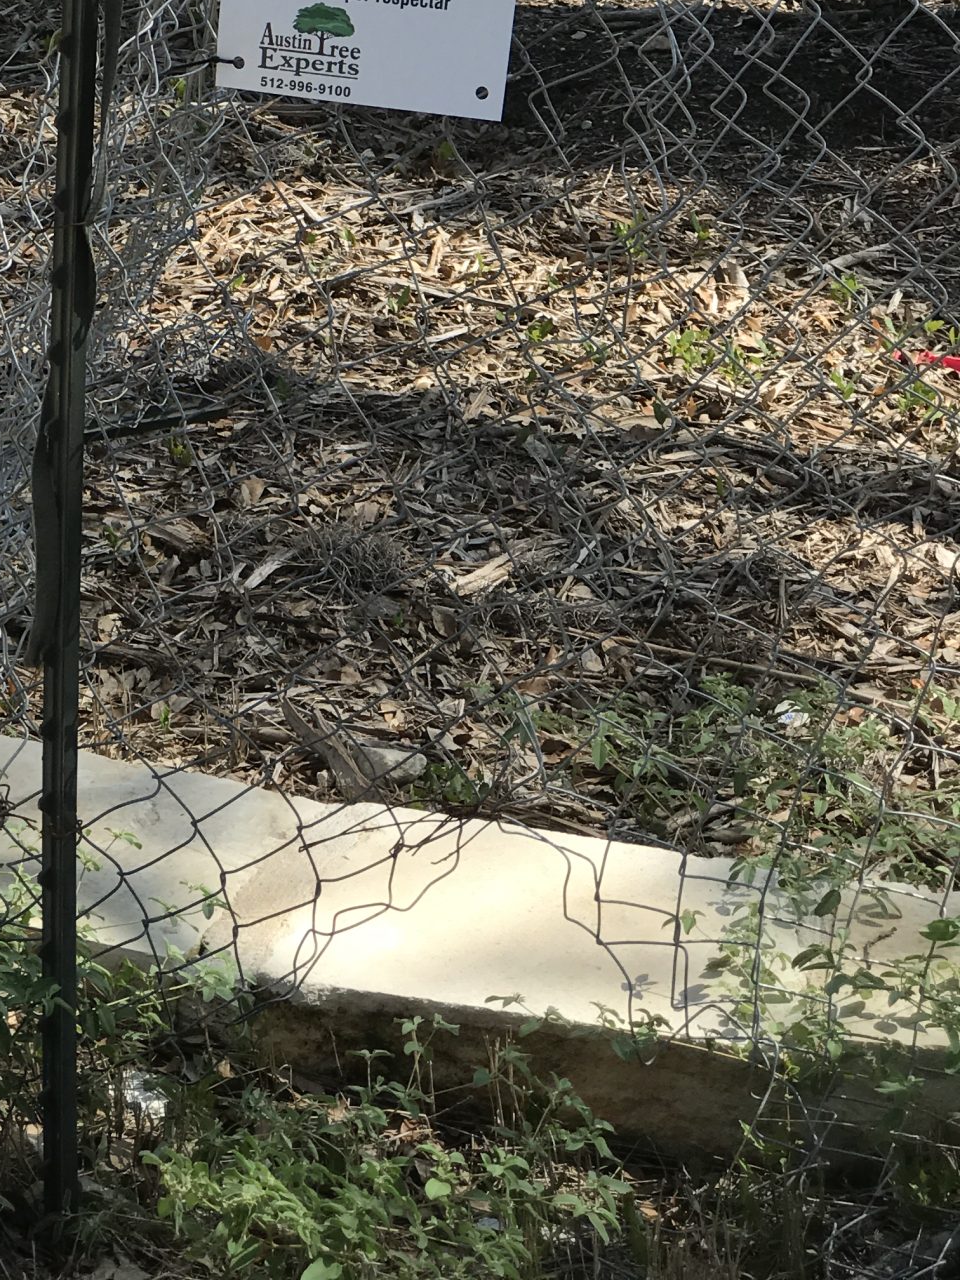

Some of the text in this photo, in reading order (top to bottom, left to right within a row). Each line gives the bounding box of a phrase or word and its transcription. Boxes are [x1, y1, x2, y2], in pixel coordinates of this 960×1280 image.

[260, 22, 312, 51] Austin
[258, 46, 360, 76] Experts
[260, 76, 351, 98] 512-996-9100
